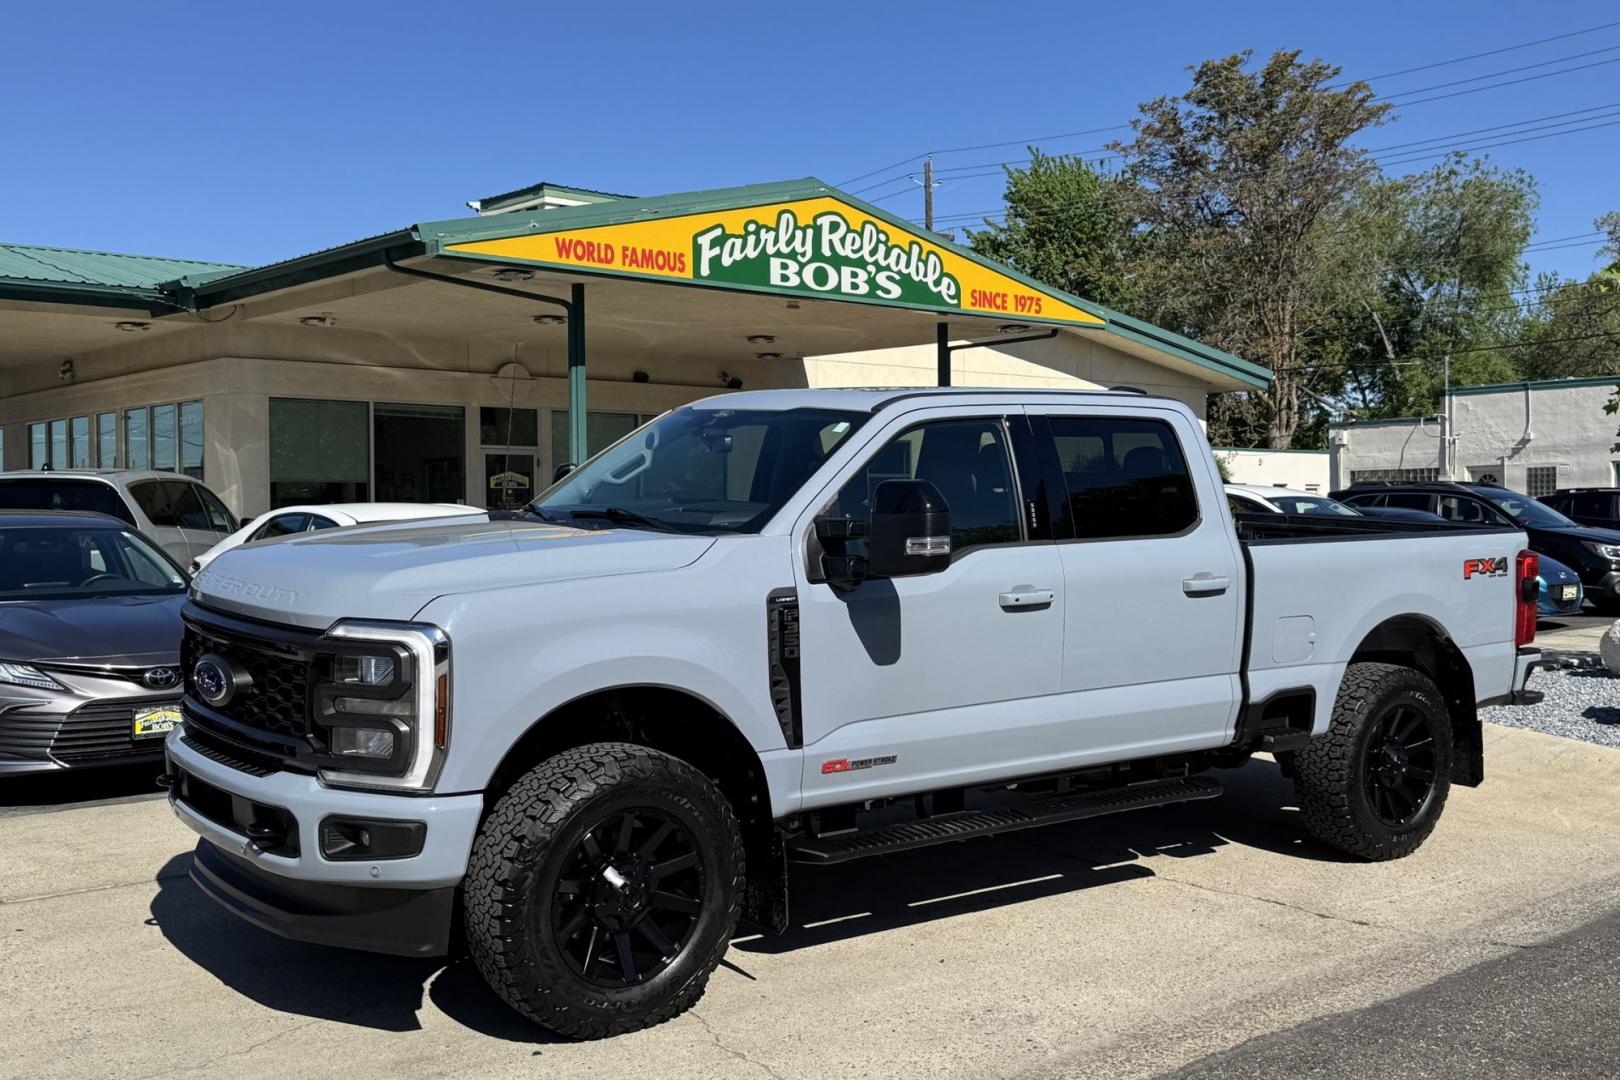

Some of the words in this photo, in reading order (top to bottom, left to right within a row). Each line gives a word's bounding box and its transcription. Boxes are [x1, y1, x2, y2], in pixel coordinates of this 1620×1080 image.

[555, 237, 614, 264] WORLD
[622, 245, 686, 273] FAMOUS
[697, 213, 813, 277] Fairly
[817, 214, 958, 304] Reliable
[770, 257, 902, 299] BOB'S
[970, 289, 1008, 310] SINCE
[1013, 294, 1042, 314] 1975
[1464, 557, 1508, 580] FX4
